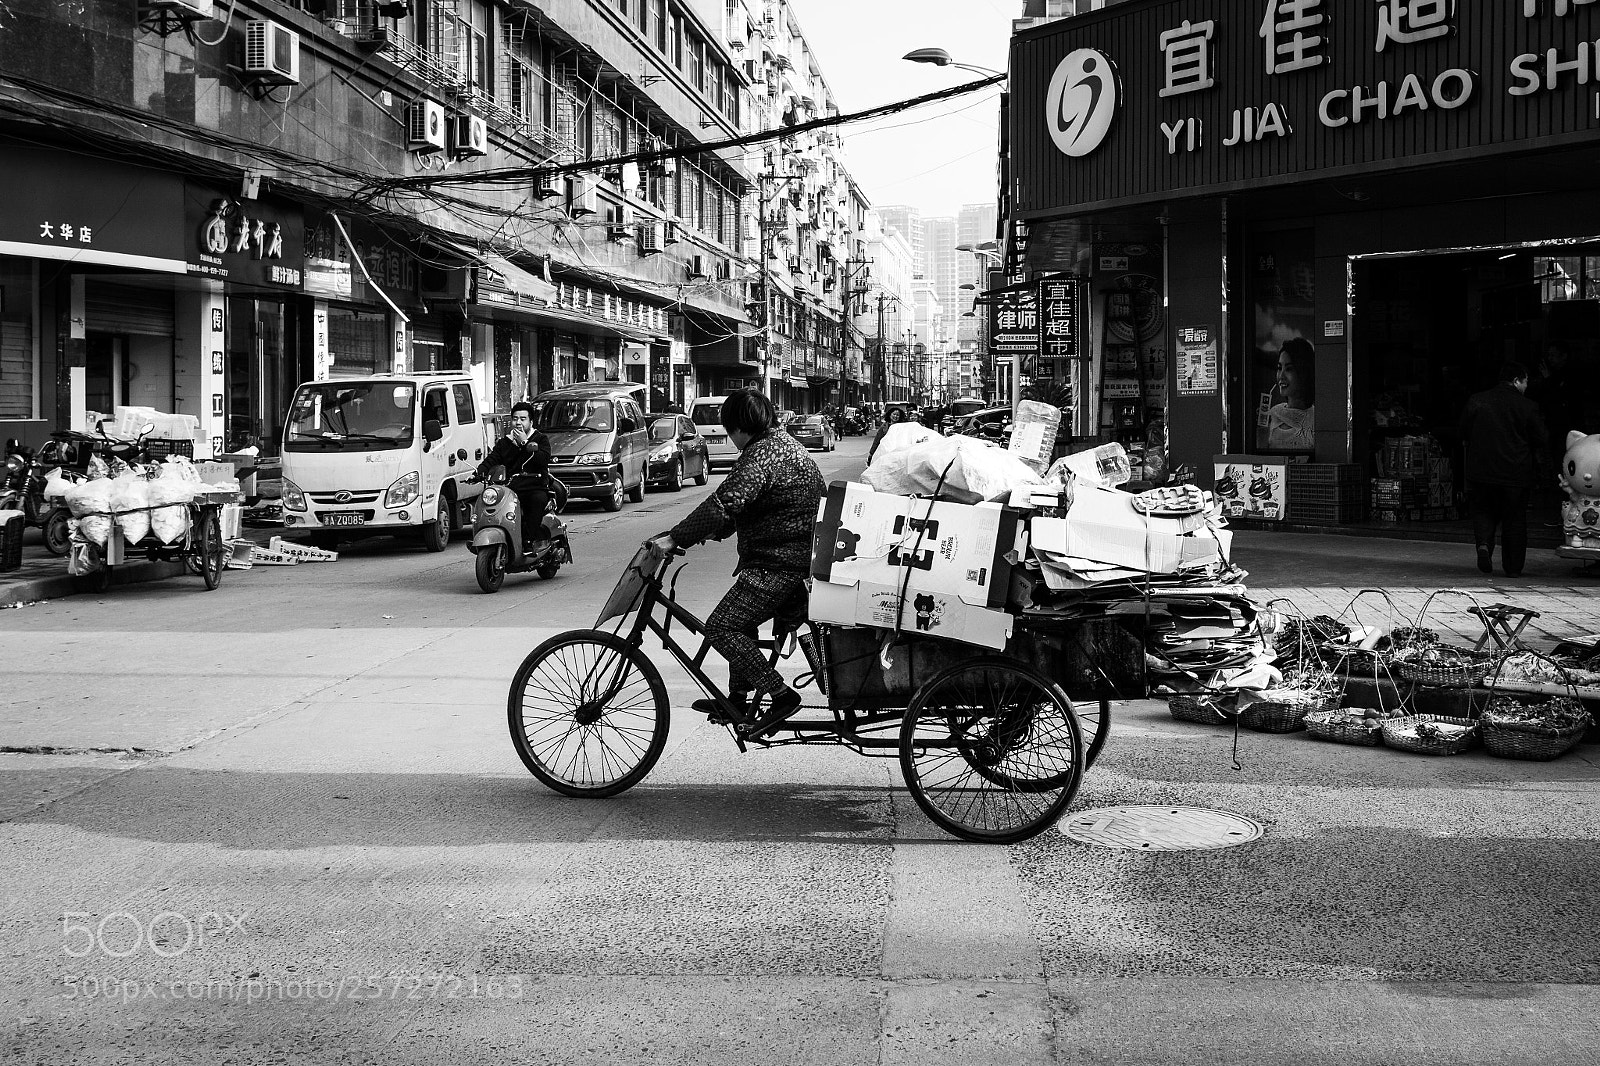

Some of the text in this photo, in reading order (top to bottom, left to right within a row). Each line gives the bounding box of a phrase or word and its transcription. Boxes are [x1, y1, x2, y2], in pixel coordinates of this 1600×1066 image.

[1161, 118, 1199, 154] YI
[1223, 102, 1291, 147] JIA
[1318, 68, 1474, 128] CHAO
[40, 220, 93, 243] 大华店
[997, 310, 1037, 330] 律师
[1046, 283, 1071, 354] 宜佳超市
[212, 308, 223, 457] 传统工艺
